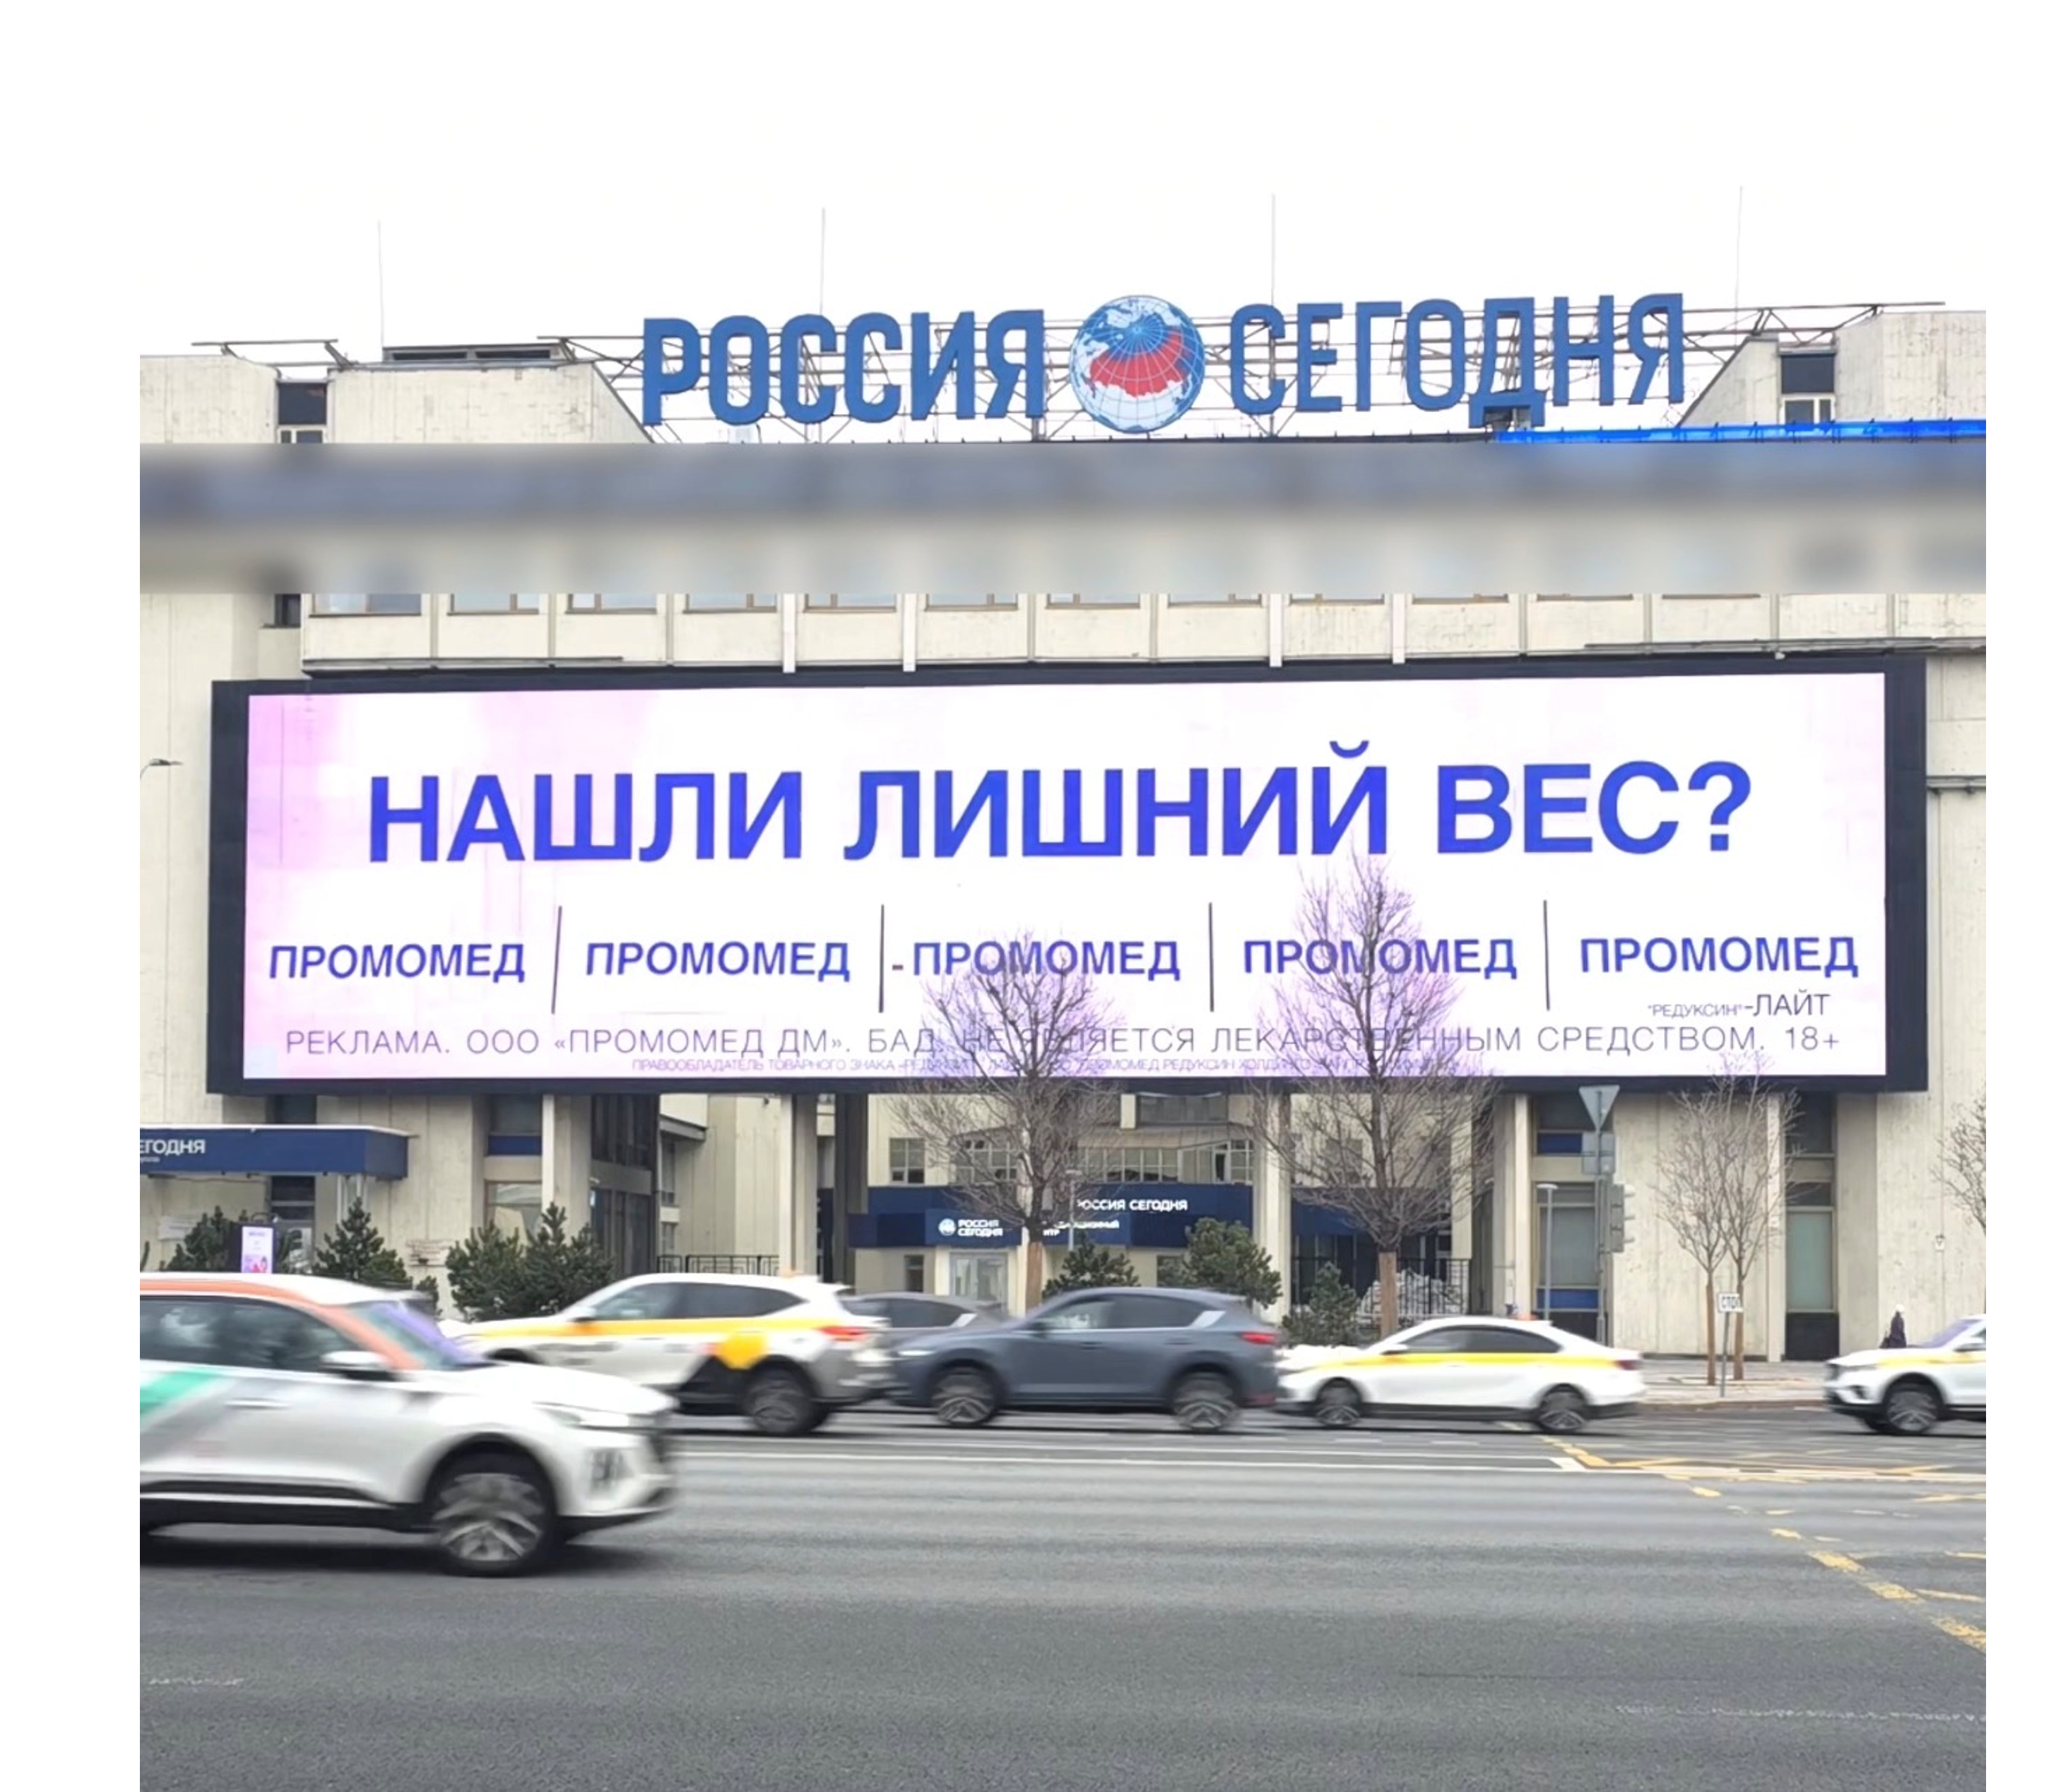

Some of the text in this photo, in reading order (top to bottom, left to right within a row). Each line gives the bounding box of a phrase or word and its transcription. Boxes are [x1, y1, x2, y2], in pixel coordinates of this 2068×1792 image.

[643, 293, 1686, 428] РОССИЯ СЕГОДНЯ
[369, 741, 1752, 863] НАШЛИ ЛИШНИЙ ВЕС?
[269, 943, 526, 982] ПРОМОМЕД
[586, 941, 851, 982] ПРОМОМЕД
[1243, 938, 1518, 979] ПРОМОМЕД
[1580, 936, 1860, 978] ПРОМОМЕД
[286, 1030, 450, 1054] РЕКЛАМА.
[466, 1029, 540, 1054] ООО
[555, 1028, 764, 1058] «ПРОМОМЕД
[777, 1028, 851, 1057] ДМ».
[963, 1028, 1005, 1053] НЕ
[1211, 1027, 1521, 1051] ЛЕКАРСТВЕННЫМ
[1537, 1025, 1765, 1056] СРЕДСТВОМ.
[1785, 1025, 1840, 1050] 18+
[1129, 1199, 1188, 1213] СЕГОДНЯ
